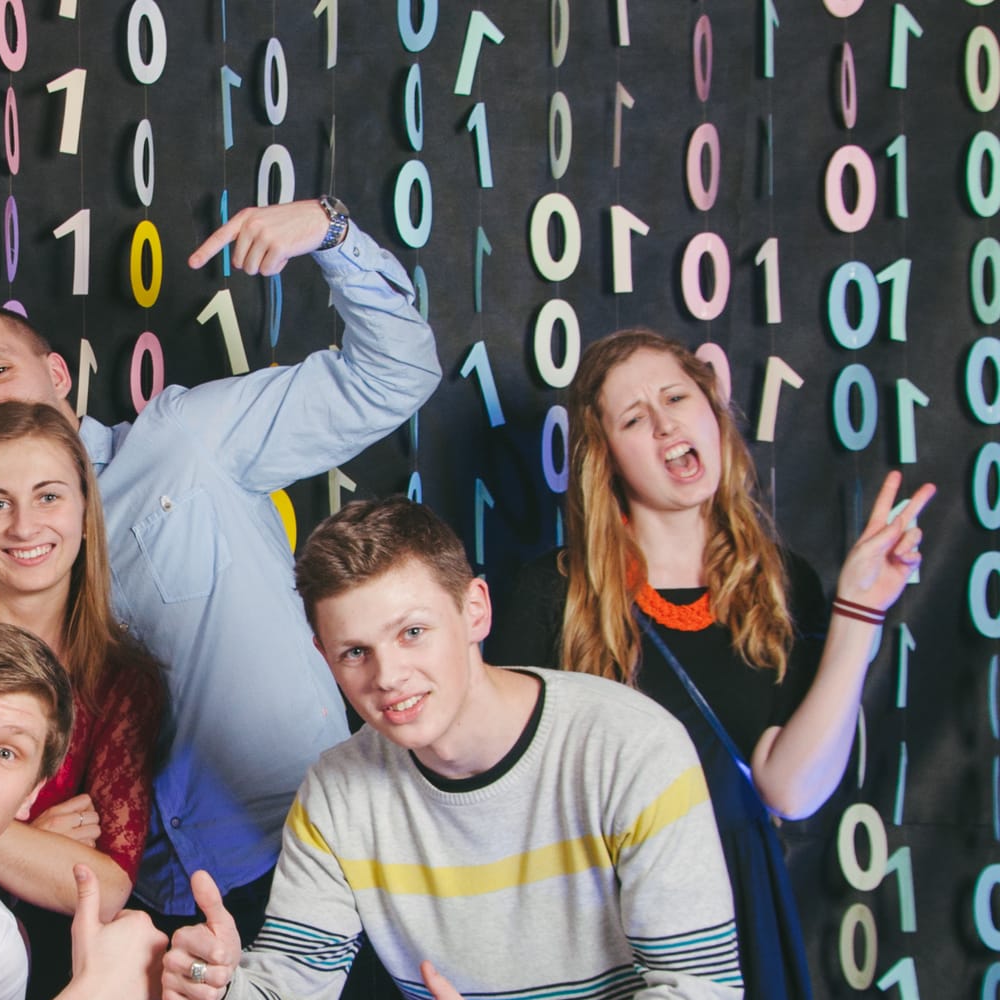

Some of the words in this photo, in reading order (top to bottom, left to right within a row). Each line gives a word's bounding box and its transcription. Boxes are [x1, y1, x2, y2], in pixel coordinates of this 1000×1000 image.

[128, 0, 167, 84] 0
[313, 0, 338, 68] 1
[552, 0, 569, 67] 0
[694, 15, 712, 101] 0
[966, 26, 1000, 112] 0
[47, 68, 87, 154] 1
[264, 37, 288, 125] 0
[405, 63, 423, 151] 0
[841, 43, 856, 128] 0
[5, 86, 19, 175] 0
[134, 119, 154, 206] 0
[467, 102, 493, 187] 1
[550, 92, 572, 179] 0
[687, 123, 719, 211] 0
[258, 144, 295, 208] 0
[394, 160, 432, 248] 0
[826, 145, 876, 232] 0
[887, 135, 908, 218] 1
[967, 131, 1000, 217] 0
[5, 196, 19, 282] 0
[54, 209, 90, 295] 1
[130, 220, 162, 307] 0
[531, 193, 581, 281] 0
[682, 232, 730, 320] 0
[756, 238, 781, 323] 1
[828, 261, 880, 350] 0
[875, 258, 911, 342] 1
[972, 237, 1000, 324] 0
[131, 332, 164, 415] 0
[197, 289, 249, 374] 1
[534, 299, 580, 388] 0
[461, 341, 505, 427] 1
[834, 364, 878, 450] 0
[966, 337, 1000, 424] 0
[542, 405, 569, 493] 0
[974, 442, 1000, 529] 0
[969, 551, 1000, 638] 0
[837, 803, 888, 891] 0
[885, 847, 917, 932] 1
[840, 903, 877, 989] 0
